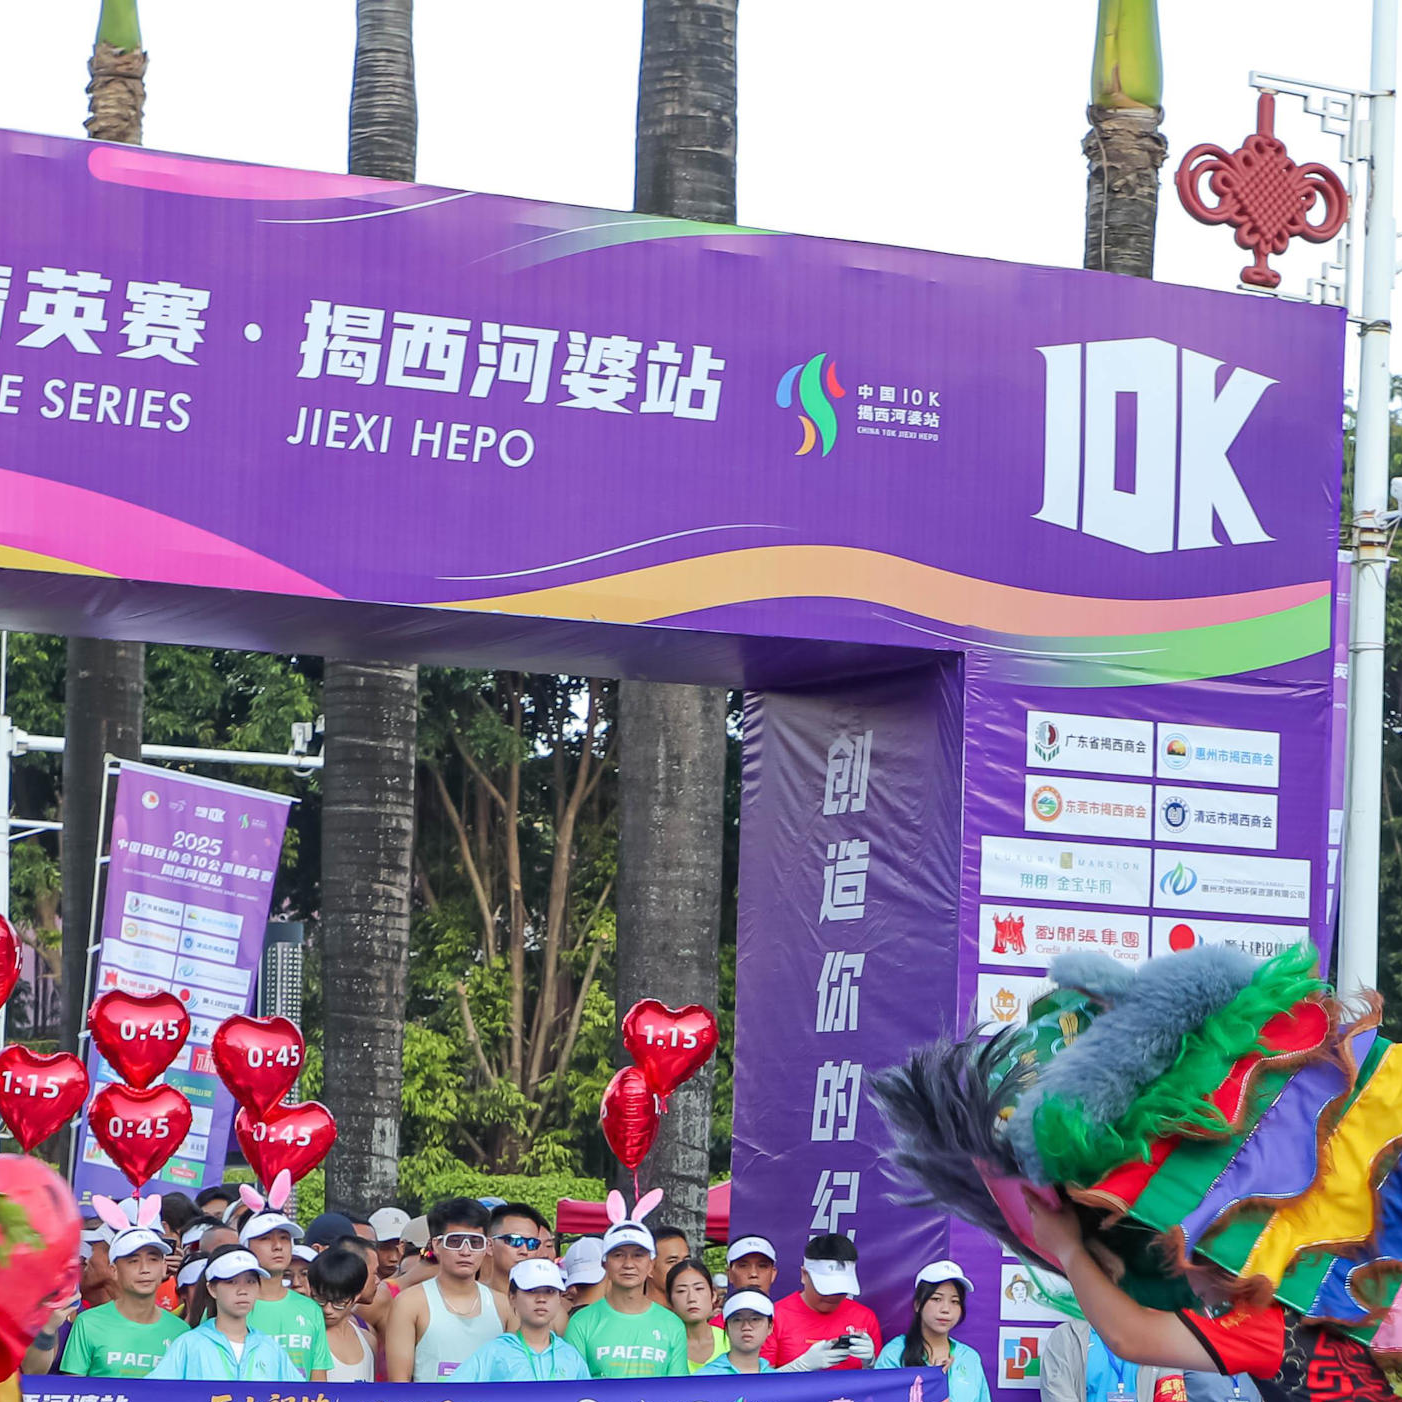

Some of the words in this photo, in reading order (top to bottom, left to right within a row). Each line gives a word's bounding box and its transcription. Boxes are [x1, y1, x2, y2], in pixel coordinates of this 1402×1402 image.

[39, 377, 192, 432] SERIES
[857, 404, 940, 428] 揭西河婆站
[287, 406, 391, 454] JIEXI
[411, 419, 536, 468] HEPO
[1030, 337, 1281, 554] 10K
[1064, 733, 1147, 754] 广东省揭西商会
[1194, 746, 1275, 767] 惠州市揭西商会
[1064, 799, 1147, 819] 东莞市揭西商会
[1193, 809, 1273, 829] 清远市揭西商会
[172, 830, 223, 856] 2025
[809, 730, 873, 1243] 创造你的纪
[120, 1019, 180, 1041] 0:45
[644, 1025, 698, 1050] 1:15
[247, 1046, 300, 1068] 0:45
[1, 1071, 60, 1099] 1:15
[108, 1117, 170, 1139] 0:45
[252, 1121, 312, 1147] 0:45
[106, 1351, 162, 1367] PACE
[596, 1345, 667, 1364] PACER
